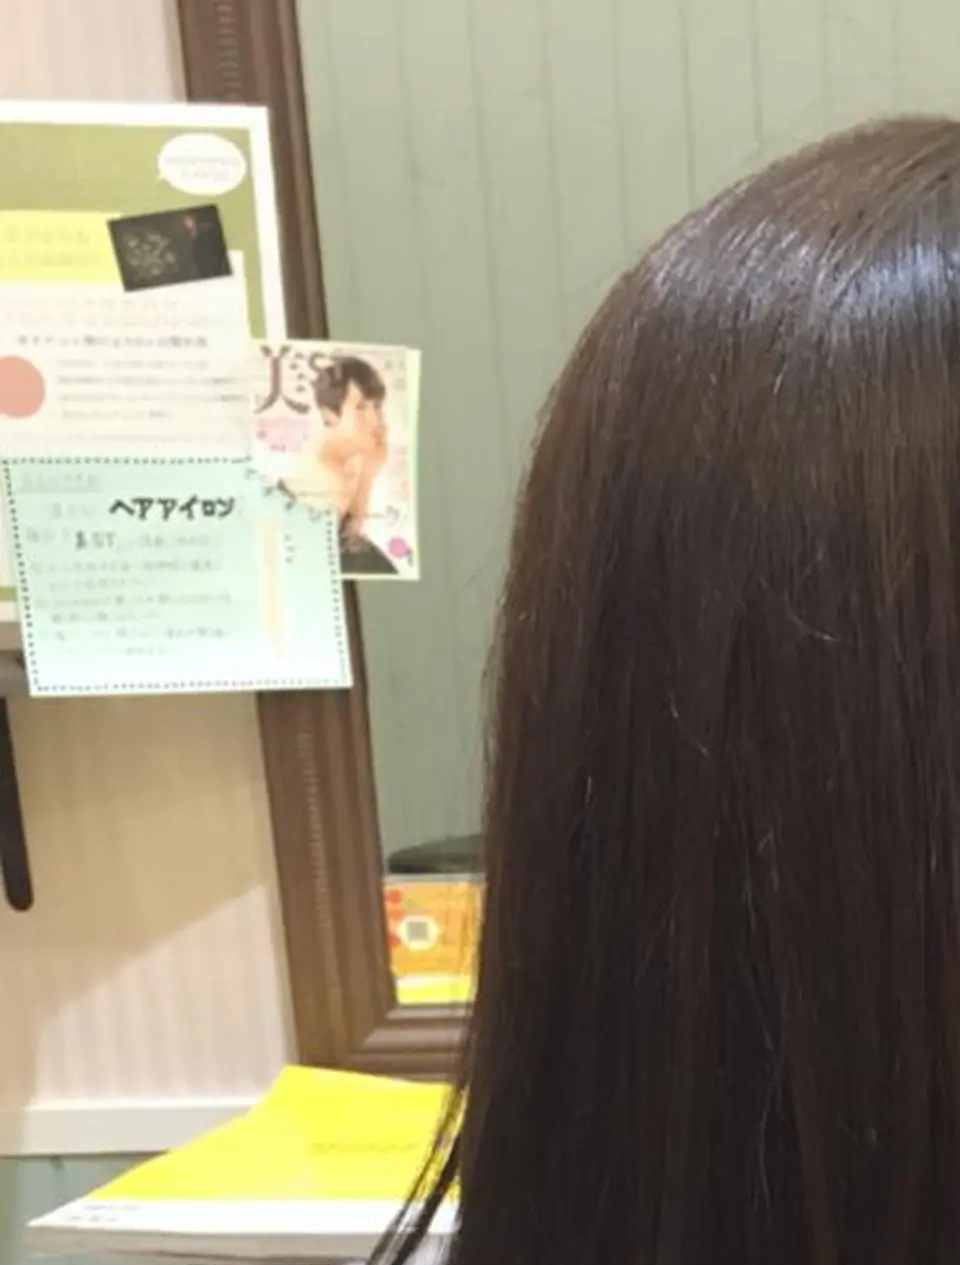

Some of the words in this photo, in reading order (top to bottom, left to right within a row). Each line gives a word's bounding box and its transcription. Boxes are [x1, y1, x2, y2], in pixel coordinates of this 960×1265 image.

[109, 495, 235, 521] ヘアアイロン
